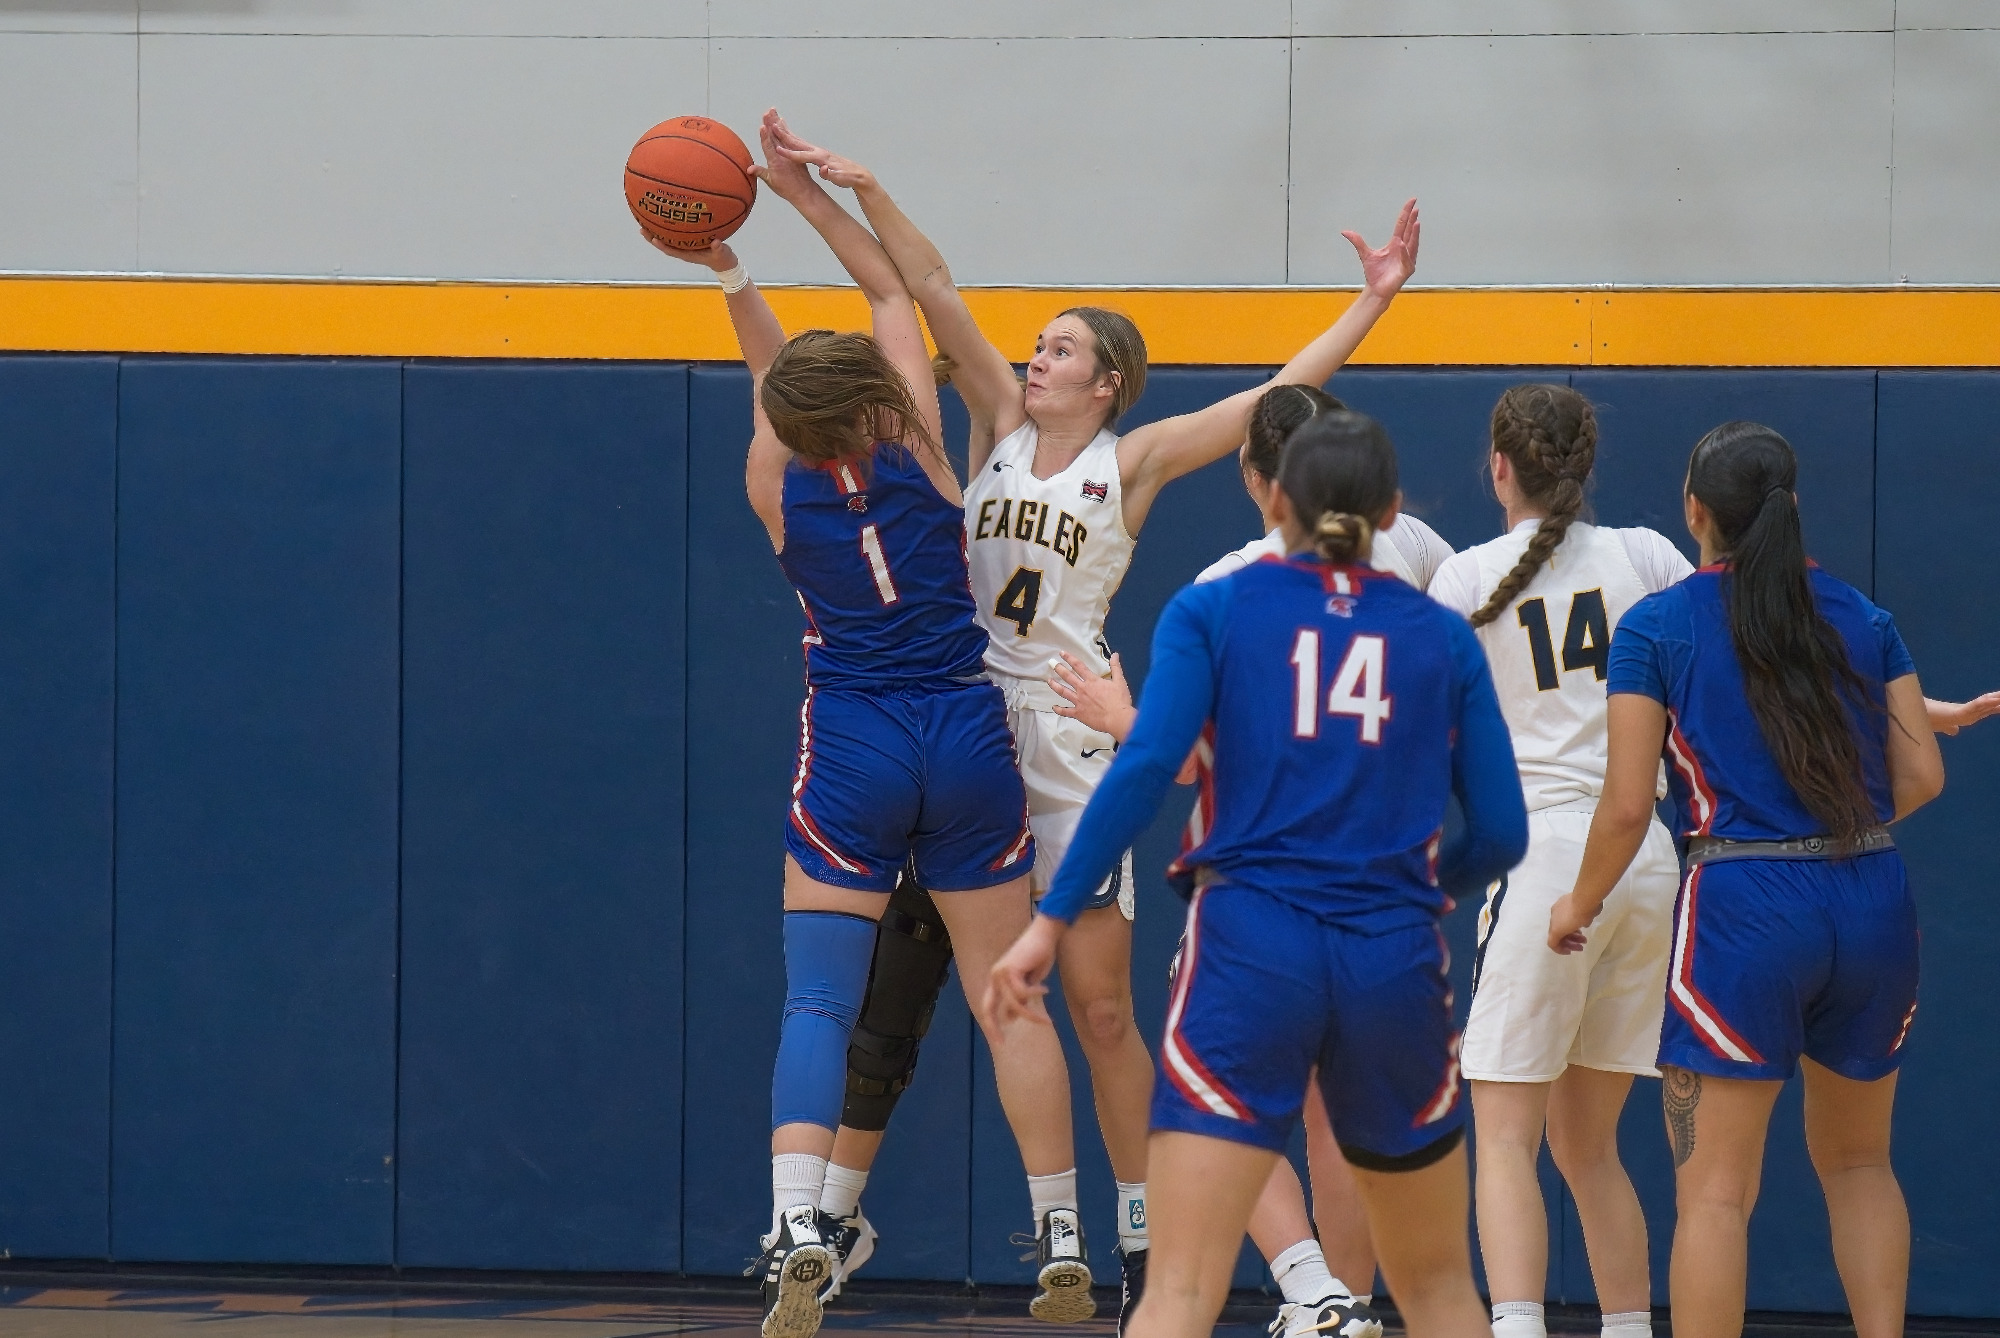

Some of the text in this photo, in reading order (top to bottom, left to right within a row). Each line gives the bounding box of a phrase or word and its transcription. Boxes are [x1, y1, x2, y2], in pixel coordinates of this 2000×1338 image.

[638, 198, 713, 224] LEGACY
[860, 522, 901, 607] 1
[974, 497, 1088, 568] EAGLES
[993, 564, 1044, 639] 4
[1515, 586, 1610, 693] 14
[1289, 627, 1393, 746] 14
